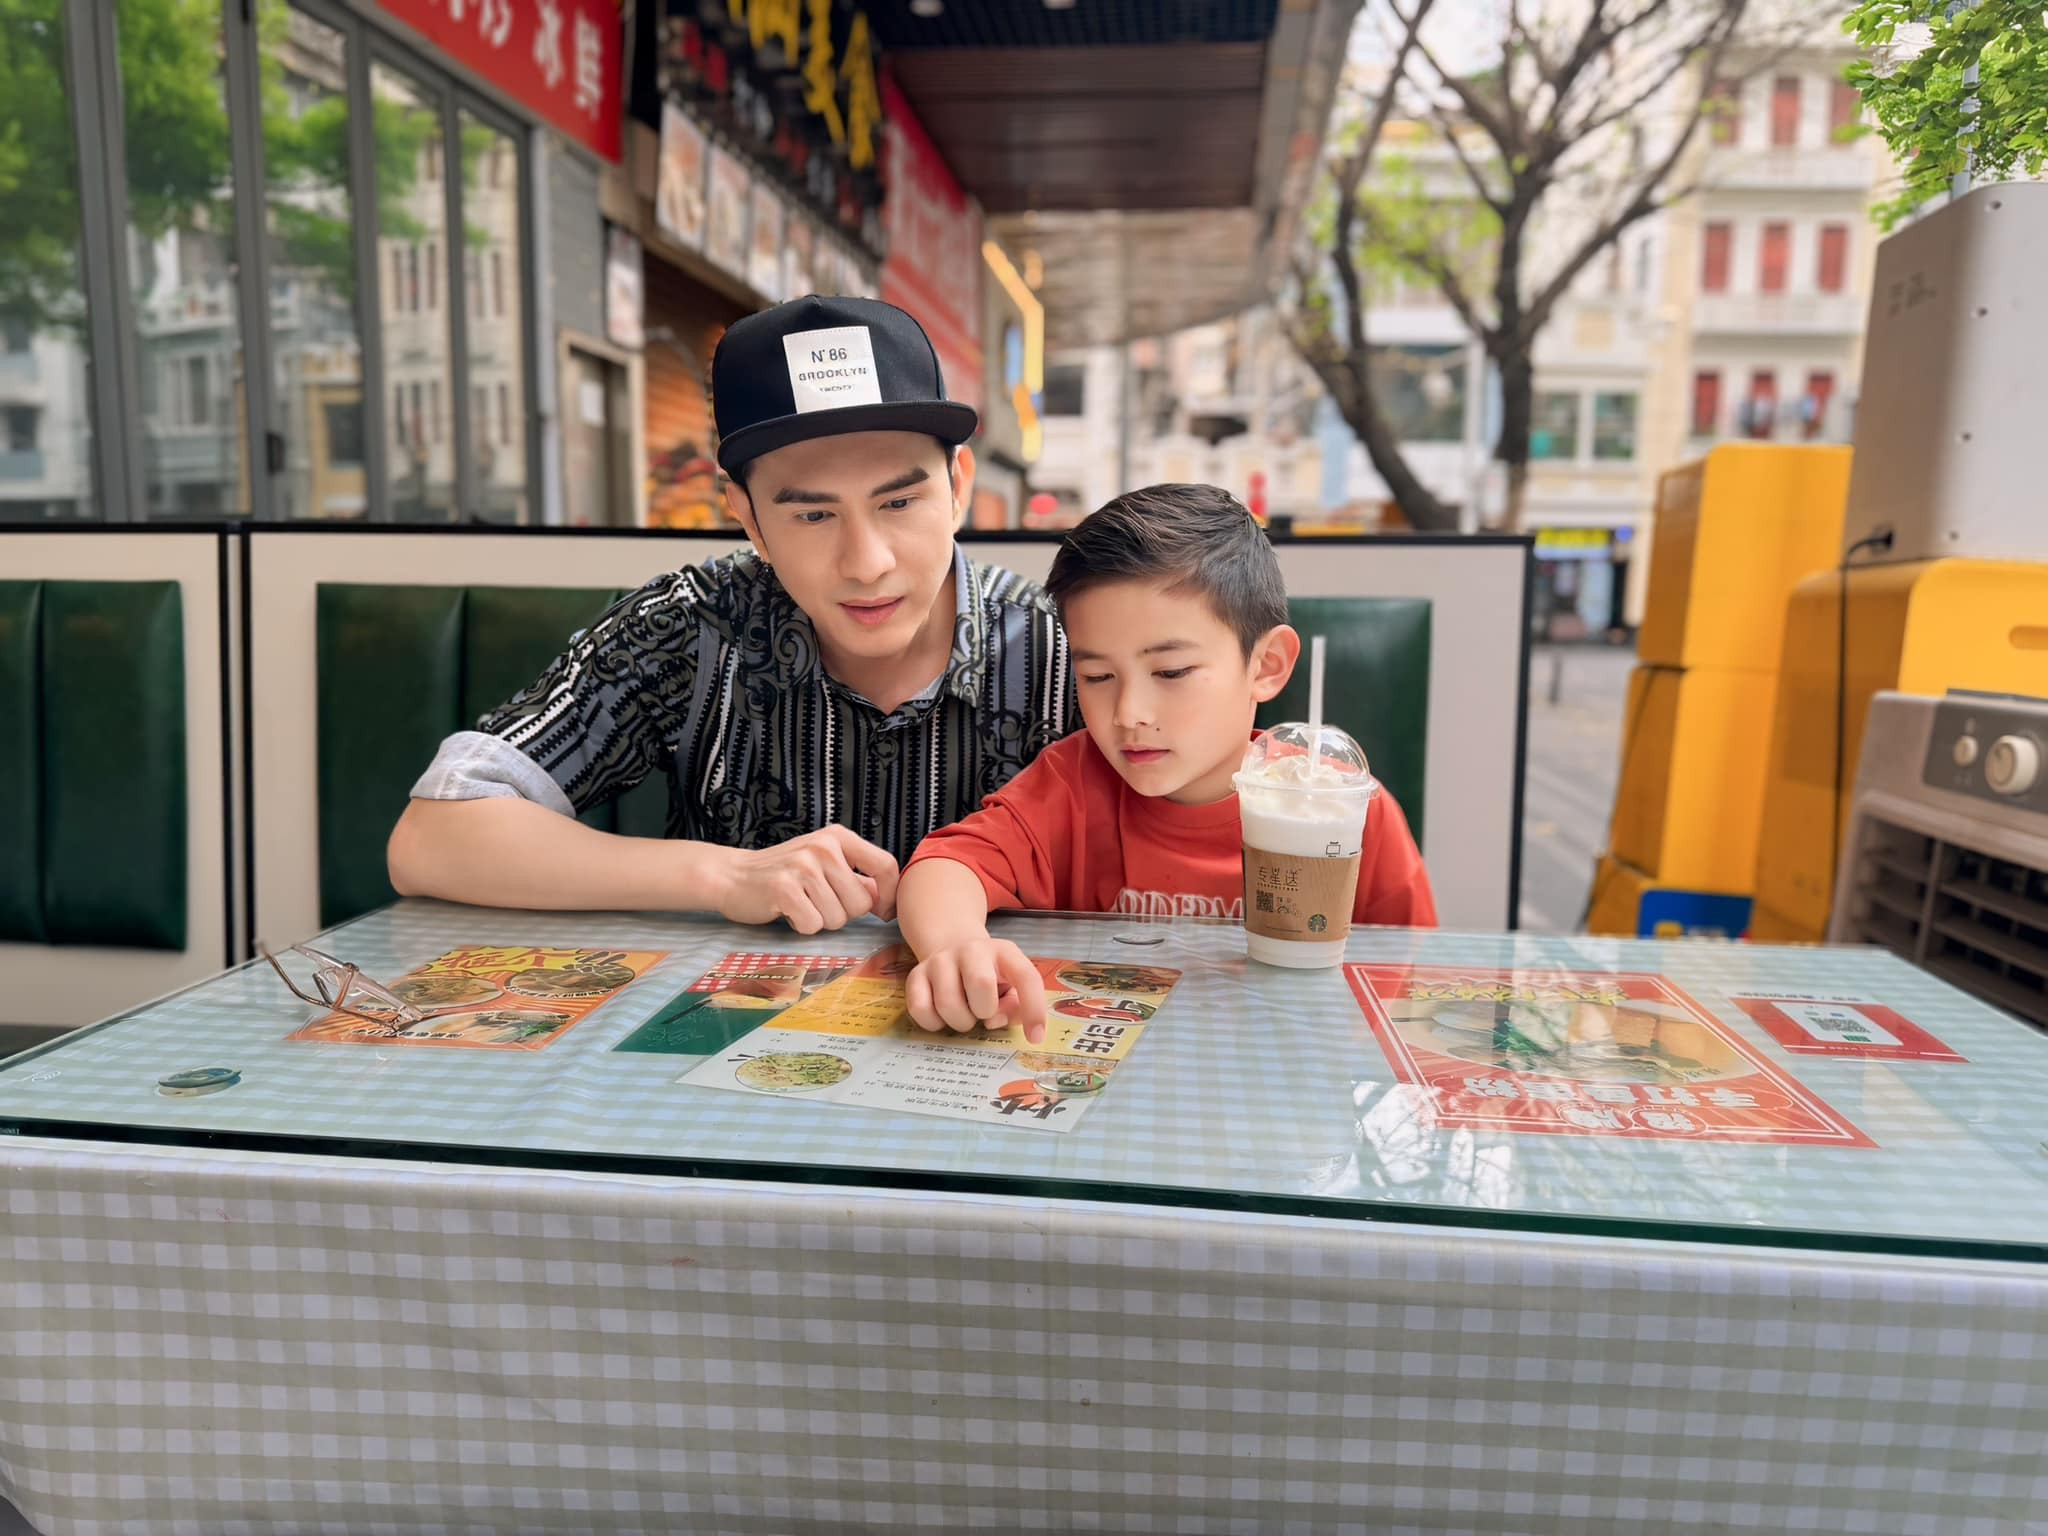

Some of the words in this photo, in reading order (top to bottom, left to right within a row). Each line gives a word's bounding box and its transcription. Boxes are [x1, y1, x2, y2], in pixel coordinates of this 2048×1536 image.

[798, 367, 867, 382] BROOKLYN
[1257, 865, 1298, 887] 专星送
[1073, 1000, 1141, 1053] 出前一丁
